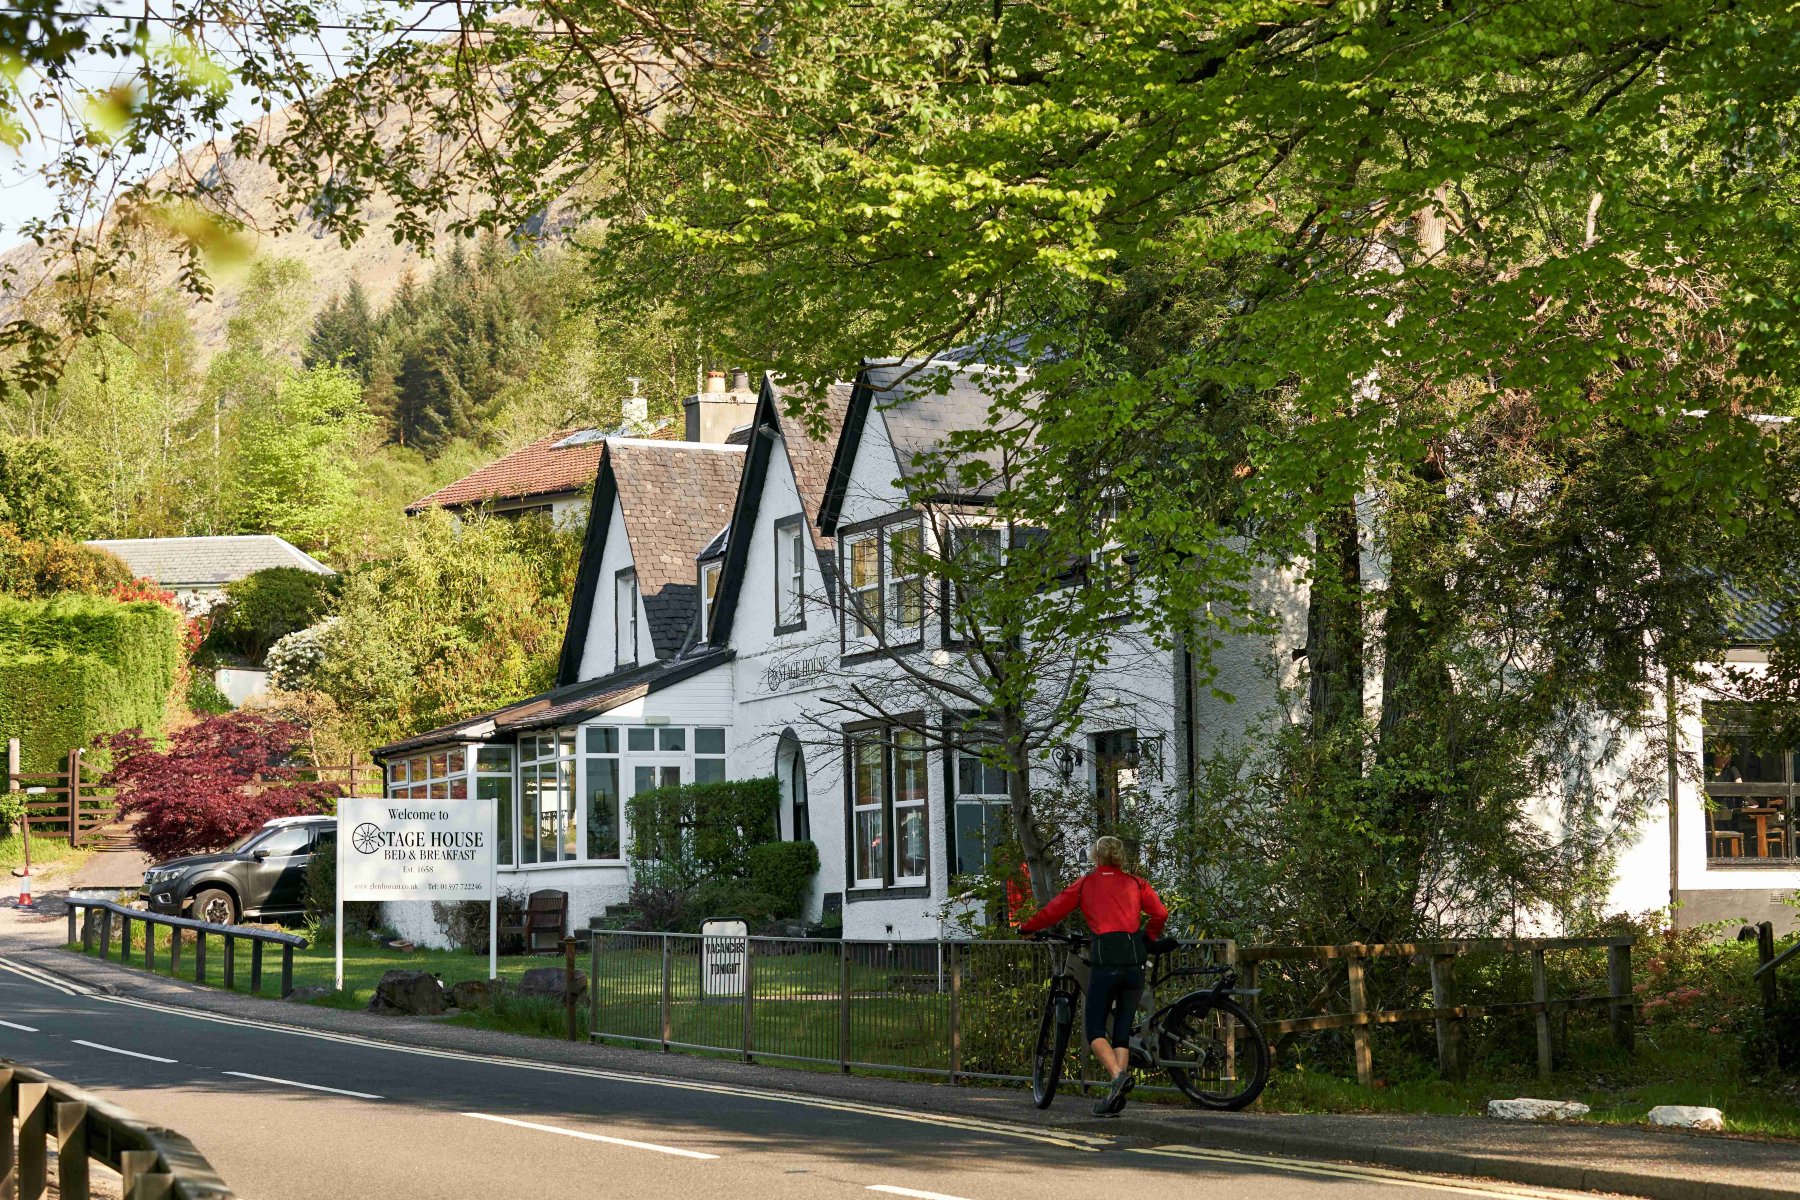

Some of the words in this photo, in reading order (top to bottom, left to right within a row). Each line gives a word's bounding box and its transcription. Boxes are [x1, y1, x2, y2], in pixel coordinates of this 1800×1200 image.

[802, 655, 828, 676] HOUSE
[388, 808, 436, 820] Welcome
[439, 810, 449, 820] to
[377, 831, 425, 848] STAGE
[431, 831, 484, 848] HOUSE
[384, 850, 406, 860] BED
[408, 850, 416, 860] &
[420, 850, 476, 860] BREAKFAST
[705, 942, 745, 954] VACANCIES
